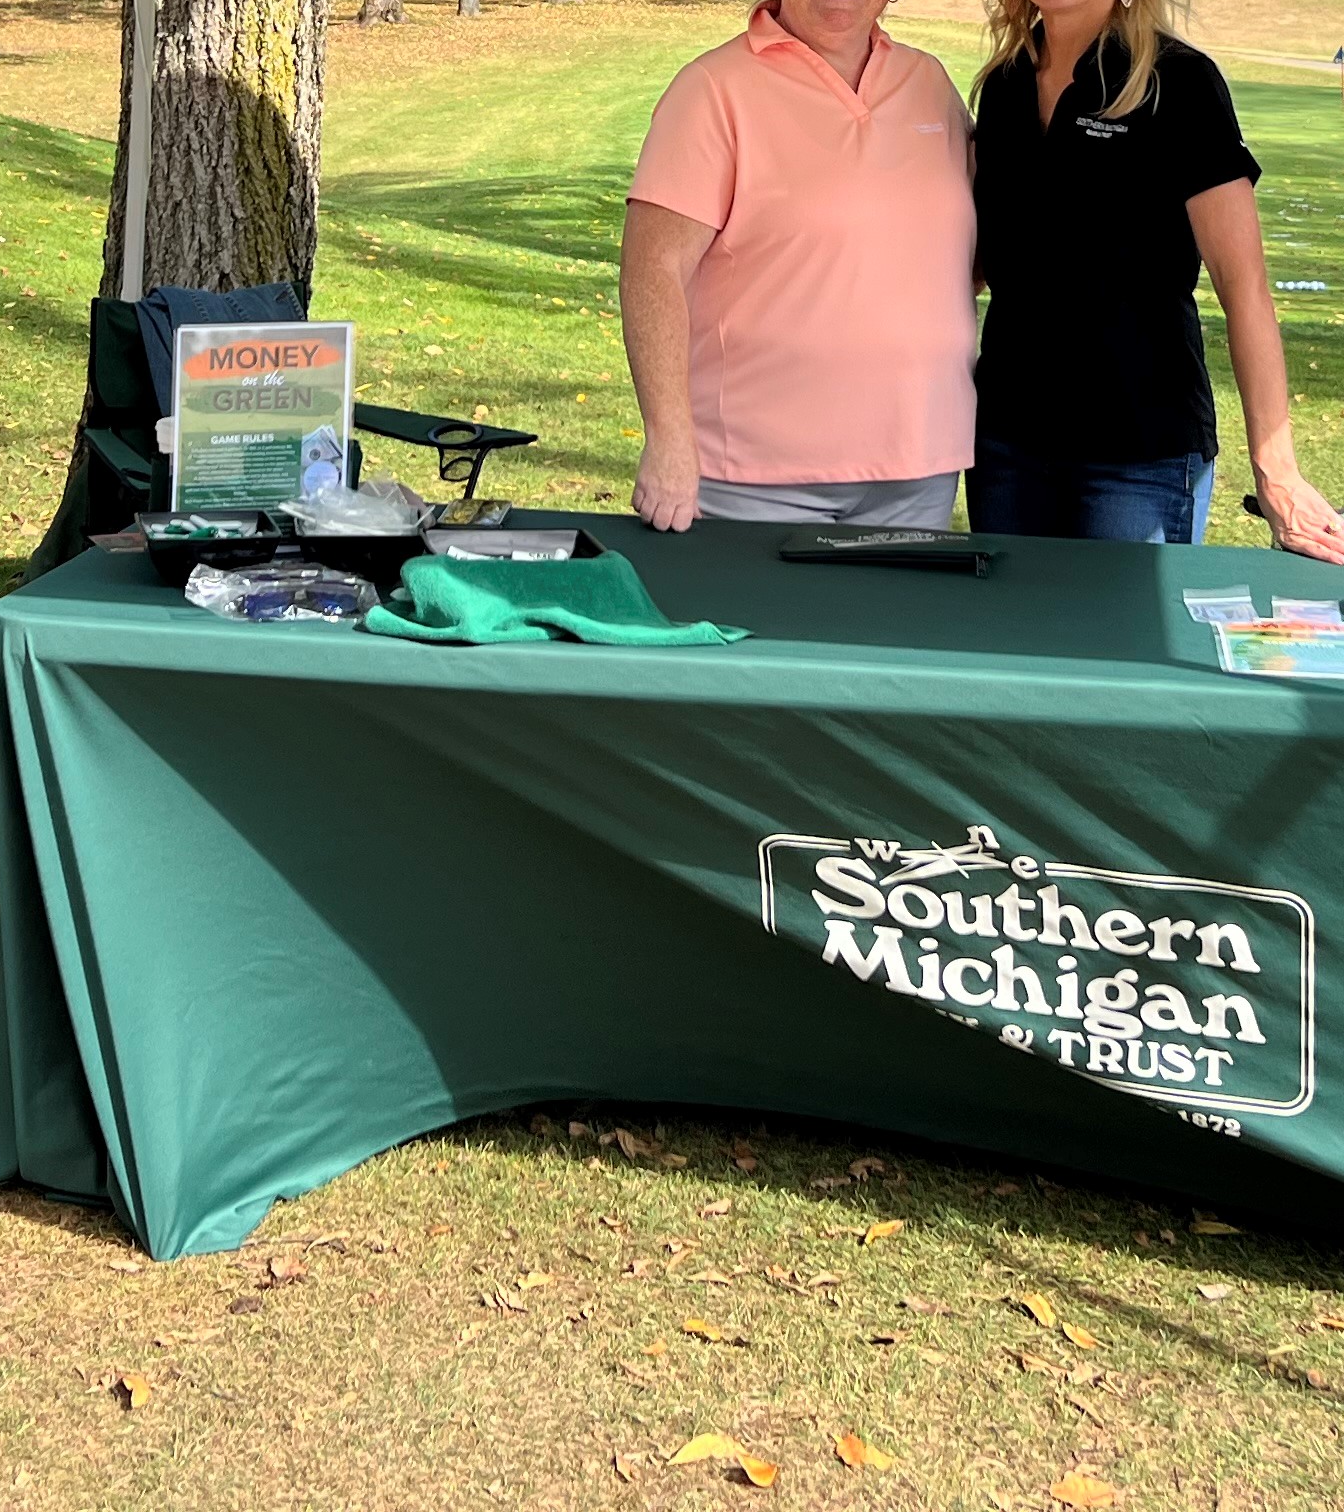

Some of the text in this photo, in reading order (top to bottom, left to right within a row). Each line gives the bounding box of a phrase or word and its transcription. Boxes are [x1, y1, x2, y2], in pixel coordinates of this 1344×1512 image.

[209, 345, 320, 371] MONEY
[241, 369, 286, 386] on the
[213, 388, 312, 412] GREEN
[210, 433, 275, 445] GAME RULES
[855, 823, 1040, 882] w n e
[811, 856, 1261, 974] Southern
[822, 919, 1268, 1044] Michigan
[1047, 1028, 1234, 1086] TRUST
